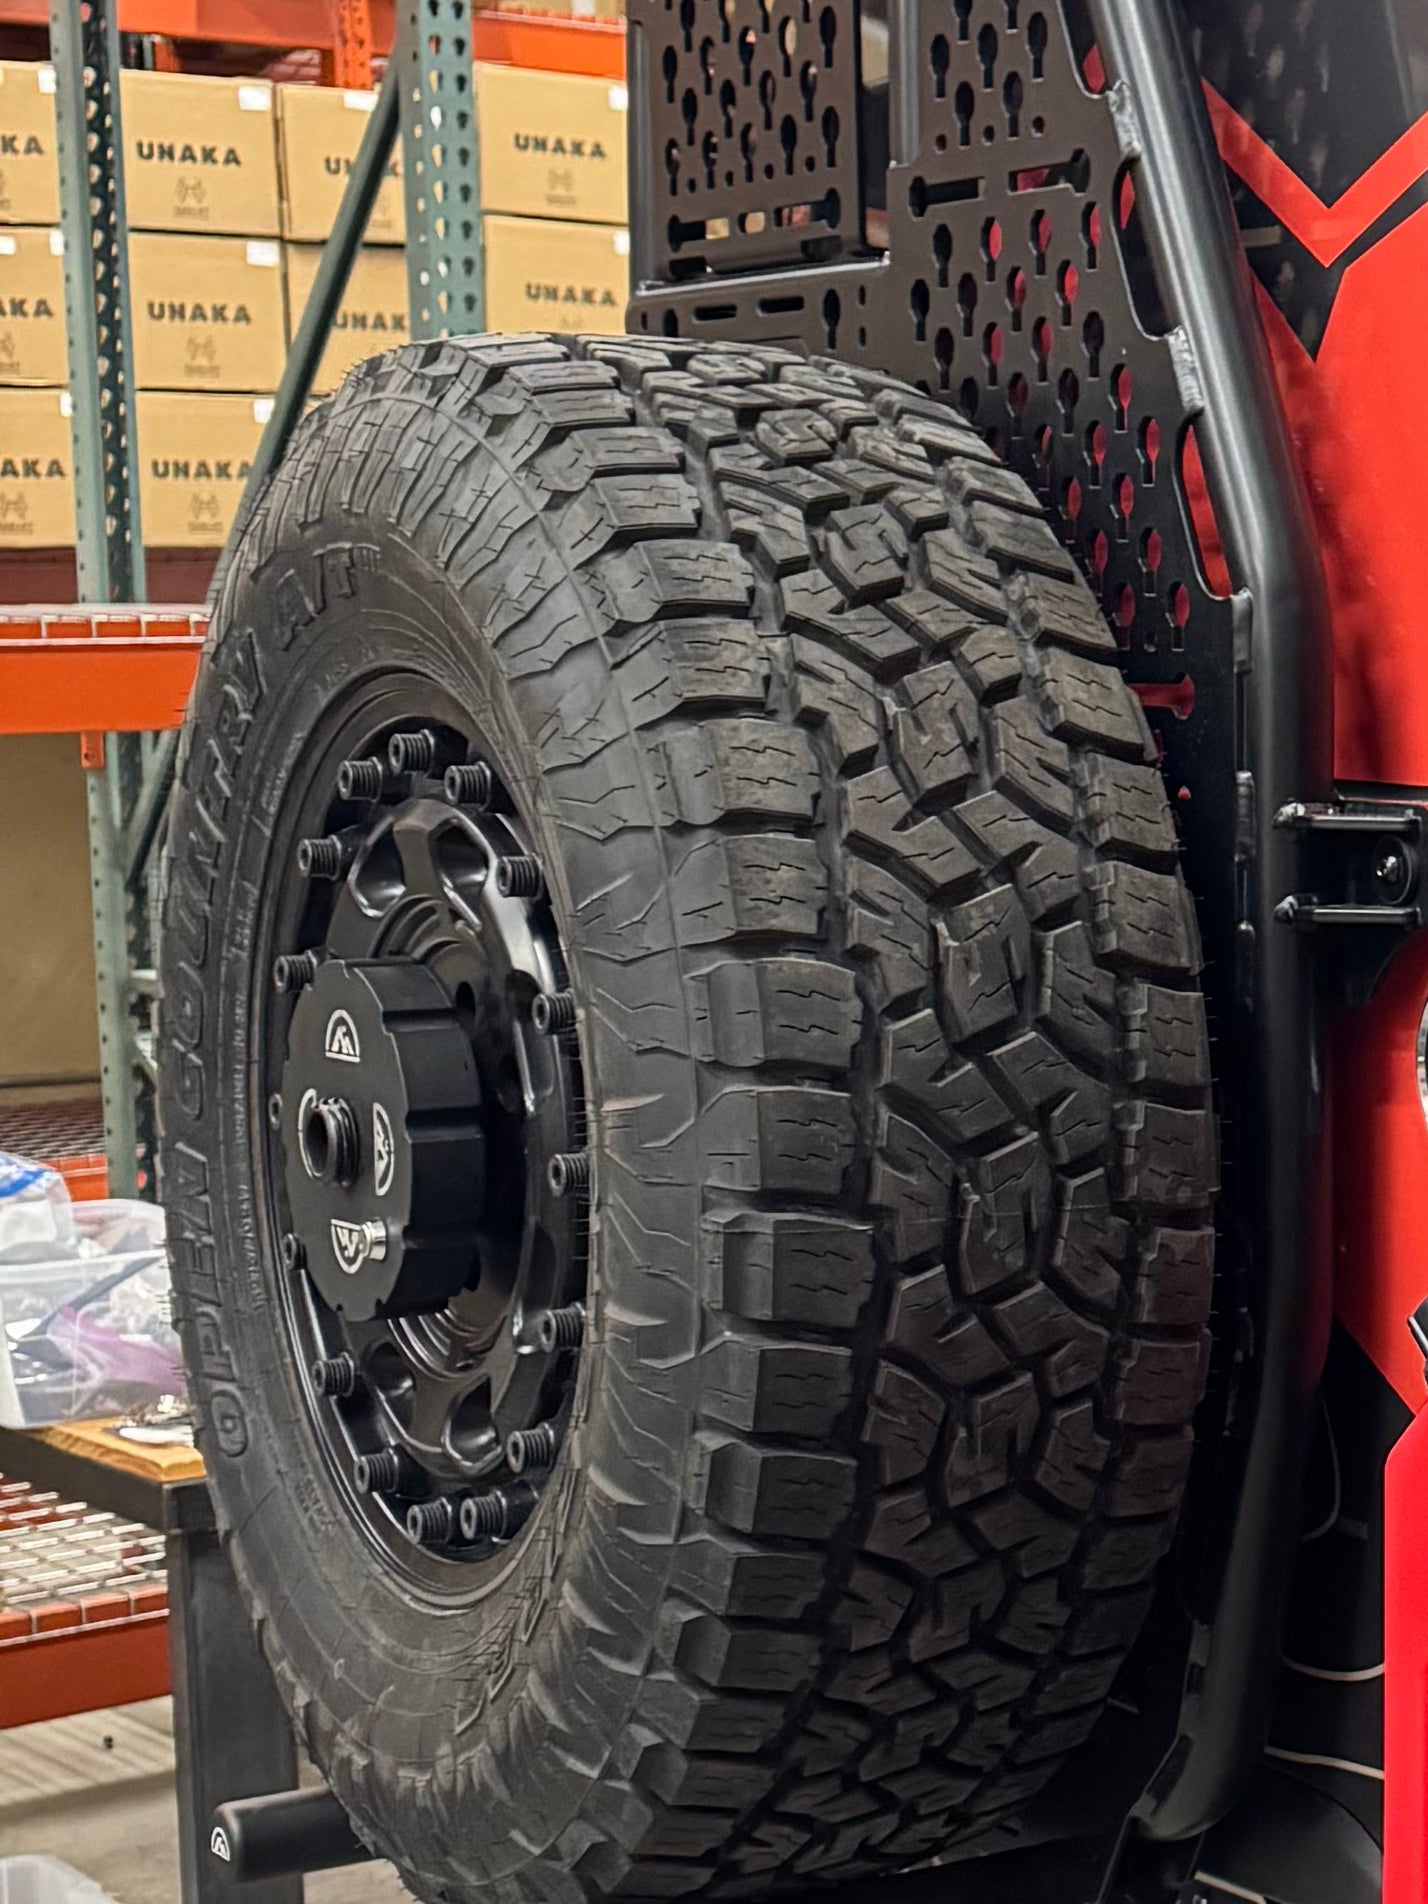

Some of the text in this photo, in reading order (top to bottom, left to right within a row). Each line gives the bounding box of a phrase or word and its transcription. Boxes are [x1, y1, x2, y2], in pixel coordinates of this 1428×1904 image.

[136, 139, 242, 167] UNAKA
[514, 132, 607, 159] UNAKA
[525, 282, 617, 307] UNAKA
[147, 301, 252, 326] UNAKA
